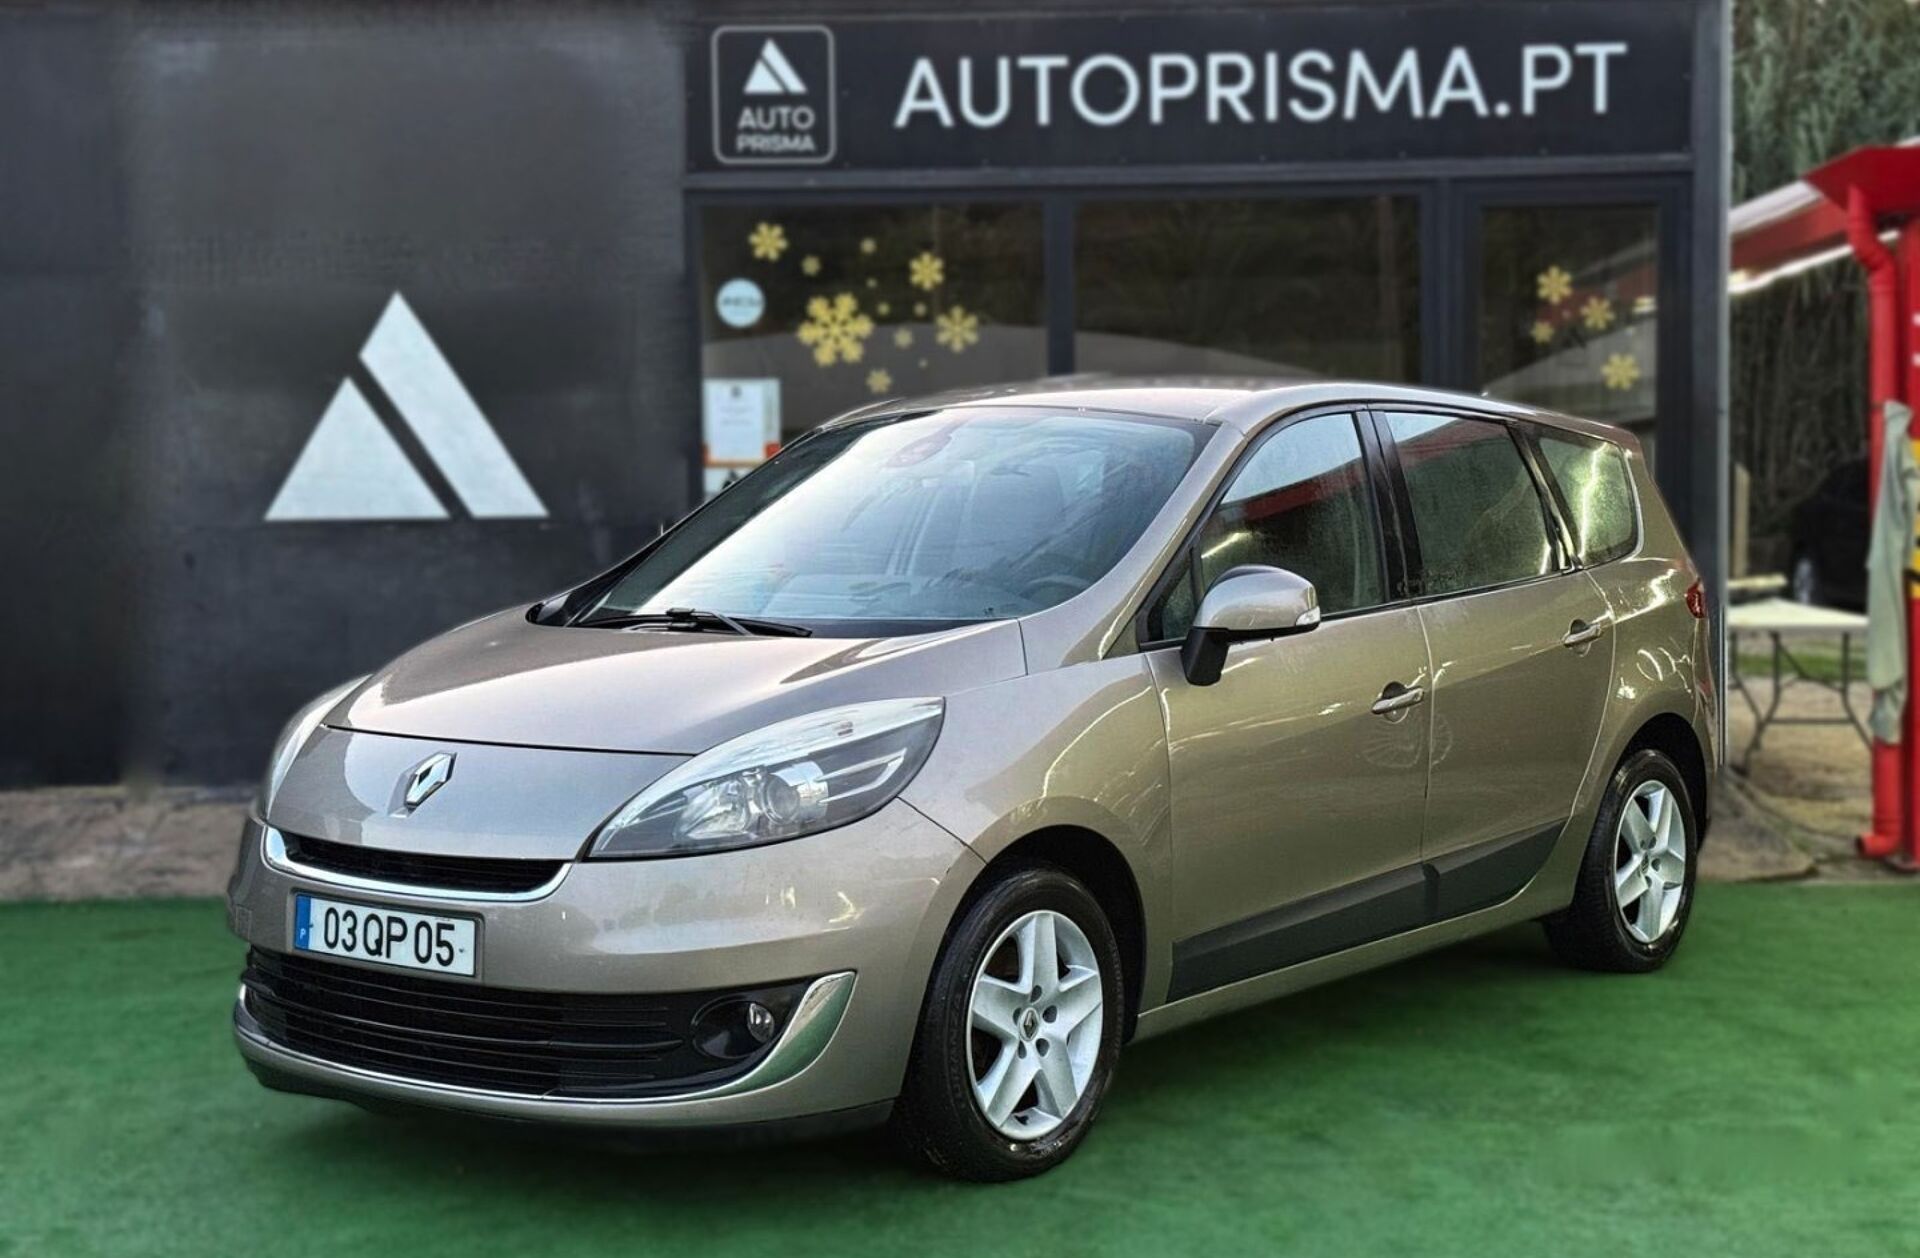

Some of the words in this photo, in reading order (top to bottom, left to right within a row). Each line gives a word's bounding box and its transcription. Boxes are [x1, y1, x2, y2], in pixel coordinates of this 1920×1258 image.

[894, 42, 1629, 127] AUTOPRISMA.PT
[737, 105, 815, 130] AUTO
[736, 132, 816, 152] PRISMA
